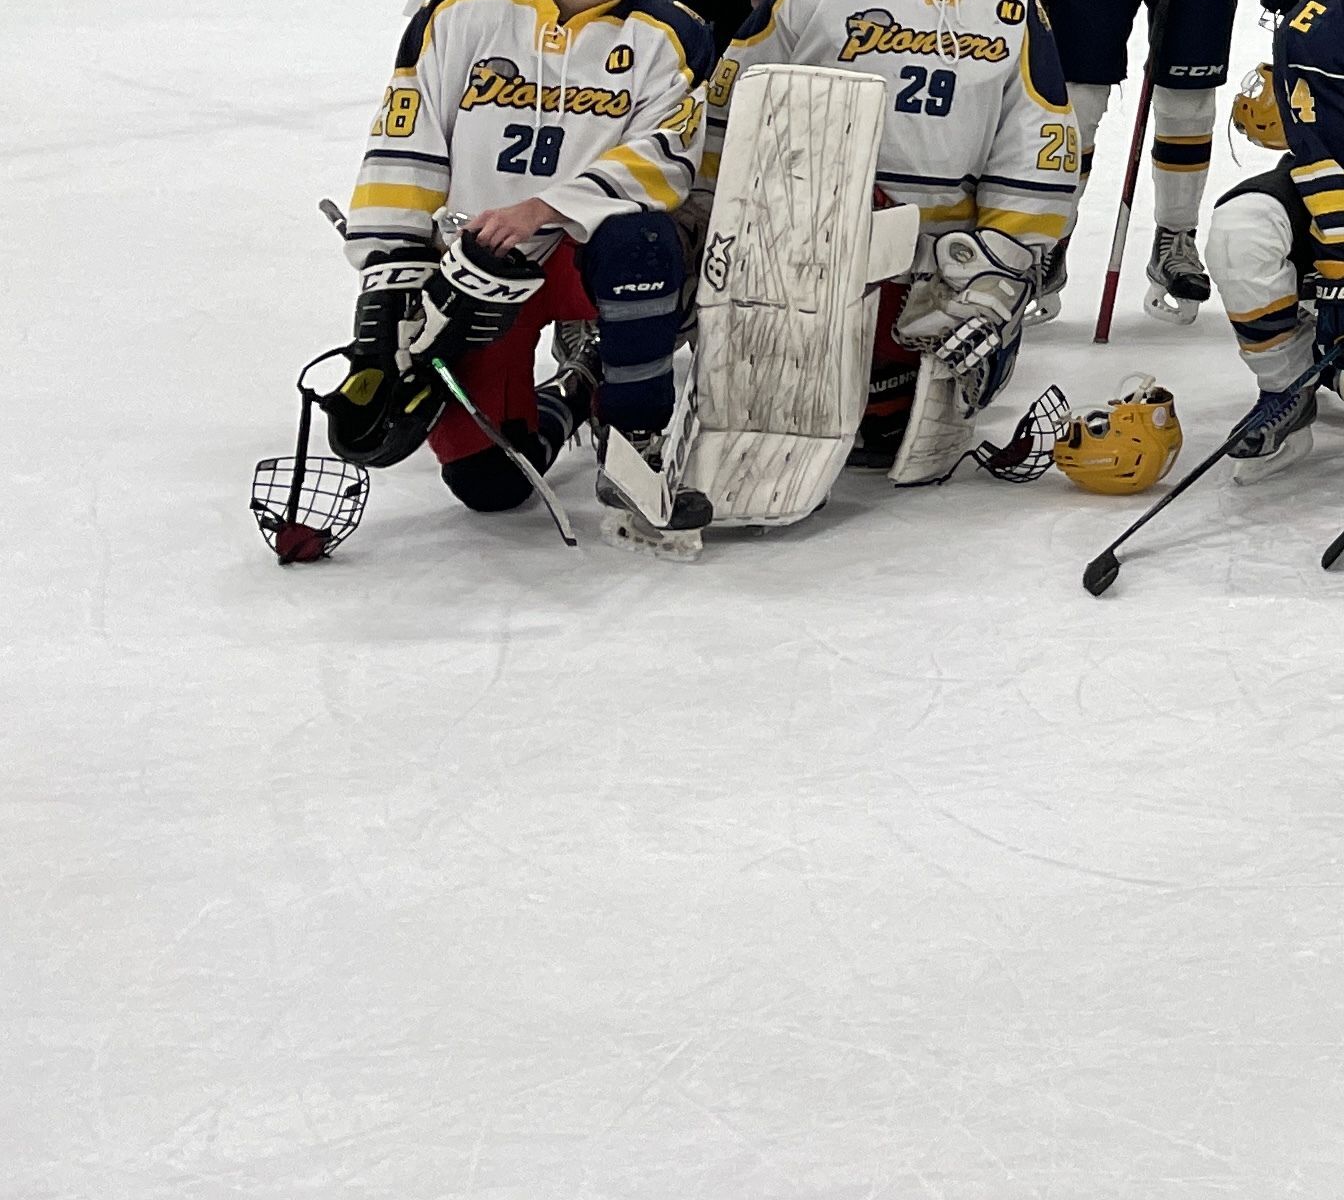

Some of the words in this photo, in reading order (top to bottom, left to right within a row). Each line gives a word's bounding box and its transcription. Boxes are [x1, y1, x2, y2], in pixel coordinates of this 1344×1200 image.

[1000, 0, 1022, 22] KJ
[1288, 0, 1327, 34] E
[607, 47, 633, 71] KJ
[838, 13, 1010, 62] Pioneers
[460, 62, 632, 118] Pioneers
[894, 64, 958, 118] 29
[1169, 63, 1224, 76] CCM
[1290, 77, 1317, 124] 4
[496, 123, 565, 177] 28
[1036, 122, 1080, 173] 29
[612, 279, 666, 296] TRON
